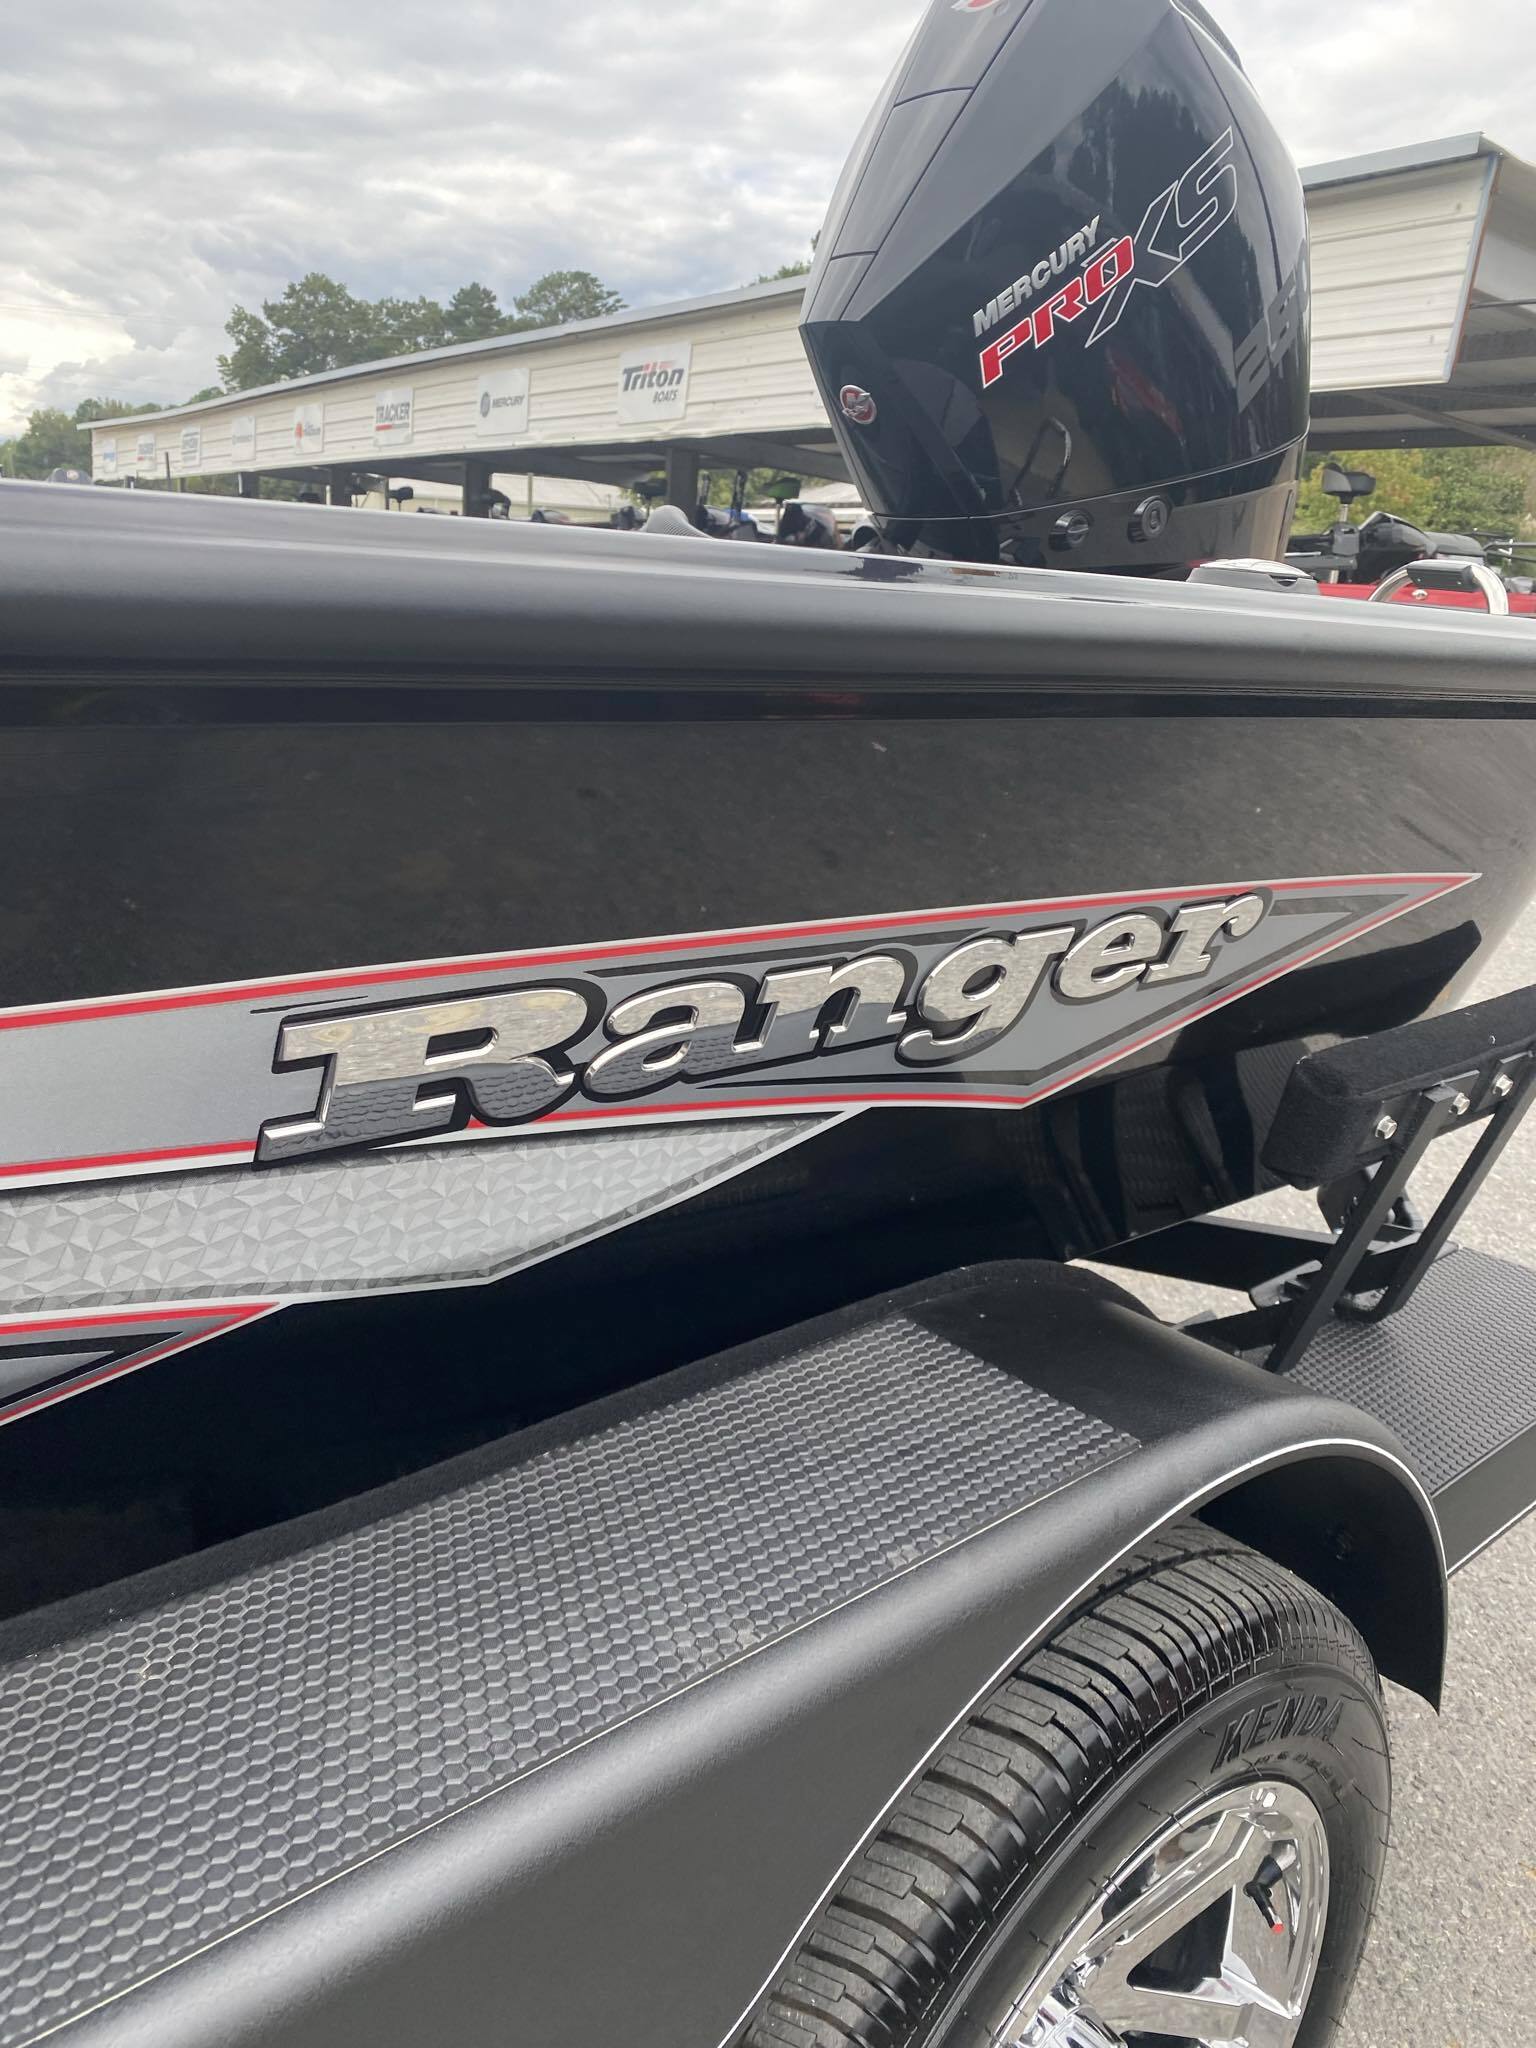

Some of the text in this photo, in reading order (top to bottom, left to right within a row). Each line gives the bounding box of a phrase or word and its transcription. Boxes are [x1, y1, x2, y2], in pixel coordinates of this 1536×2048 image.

[973, 215, 1100, 337] MERCURY
[979, 235, 1134, 389] PRO
[375, 401, 411, 424] TRACKER
[491, 394, 525, 408] MERCURY
[622, 361, 684, 392] Triton
[256, 889, 1271, 1165] Ranger
[1210, 1694, 1343, 1773] KENDA
